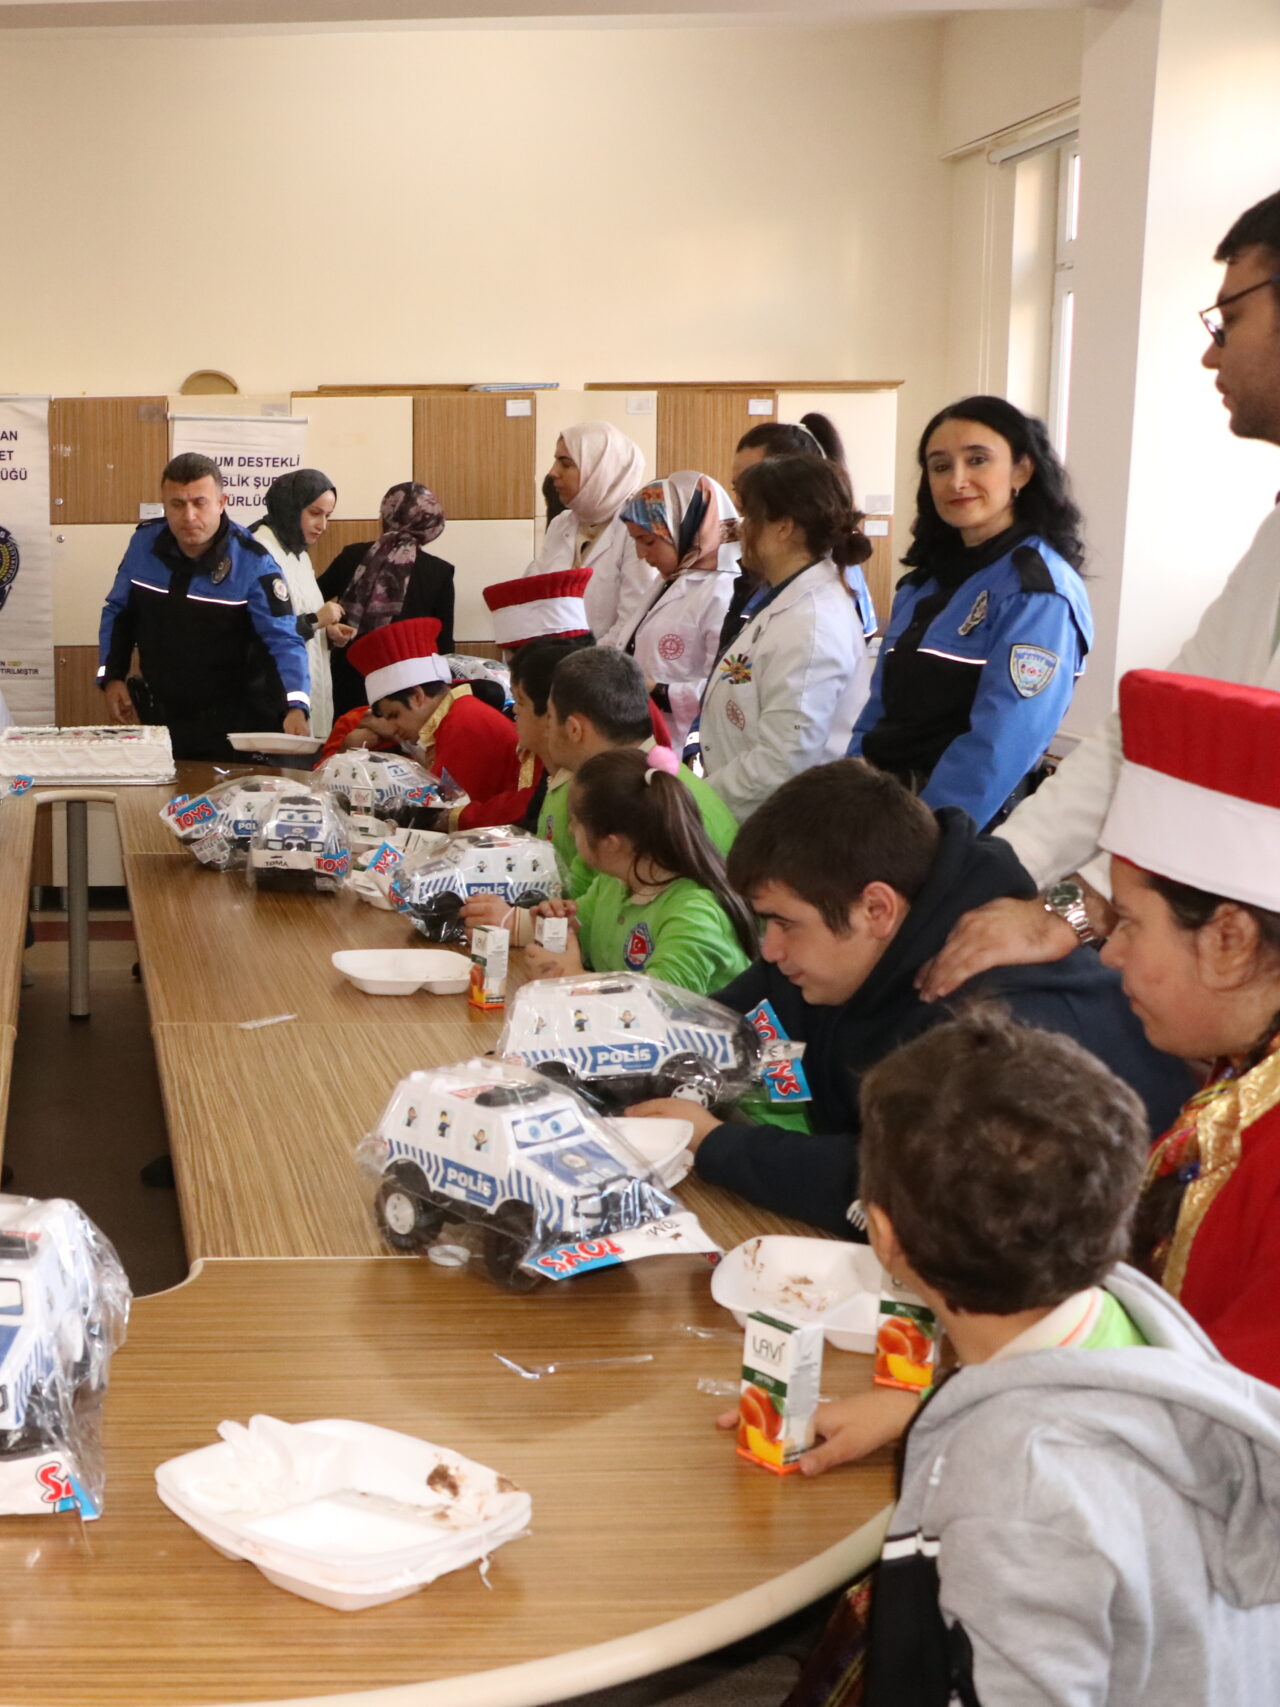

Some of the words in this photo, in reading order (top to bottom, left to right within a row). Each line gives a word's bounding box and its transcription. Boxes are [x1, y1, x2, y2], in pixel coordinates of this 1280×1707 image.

[237, 454, 300, 468] DESTEKLİ
[175, 802, 214, 832] TOYS
[470, 882, 506, 896] POLİS
[596, 1044, 652, 1065] POLİS
[447, 1166, 493, 1198] POLİS
[537, 1239, 624, 1273] TOYS
